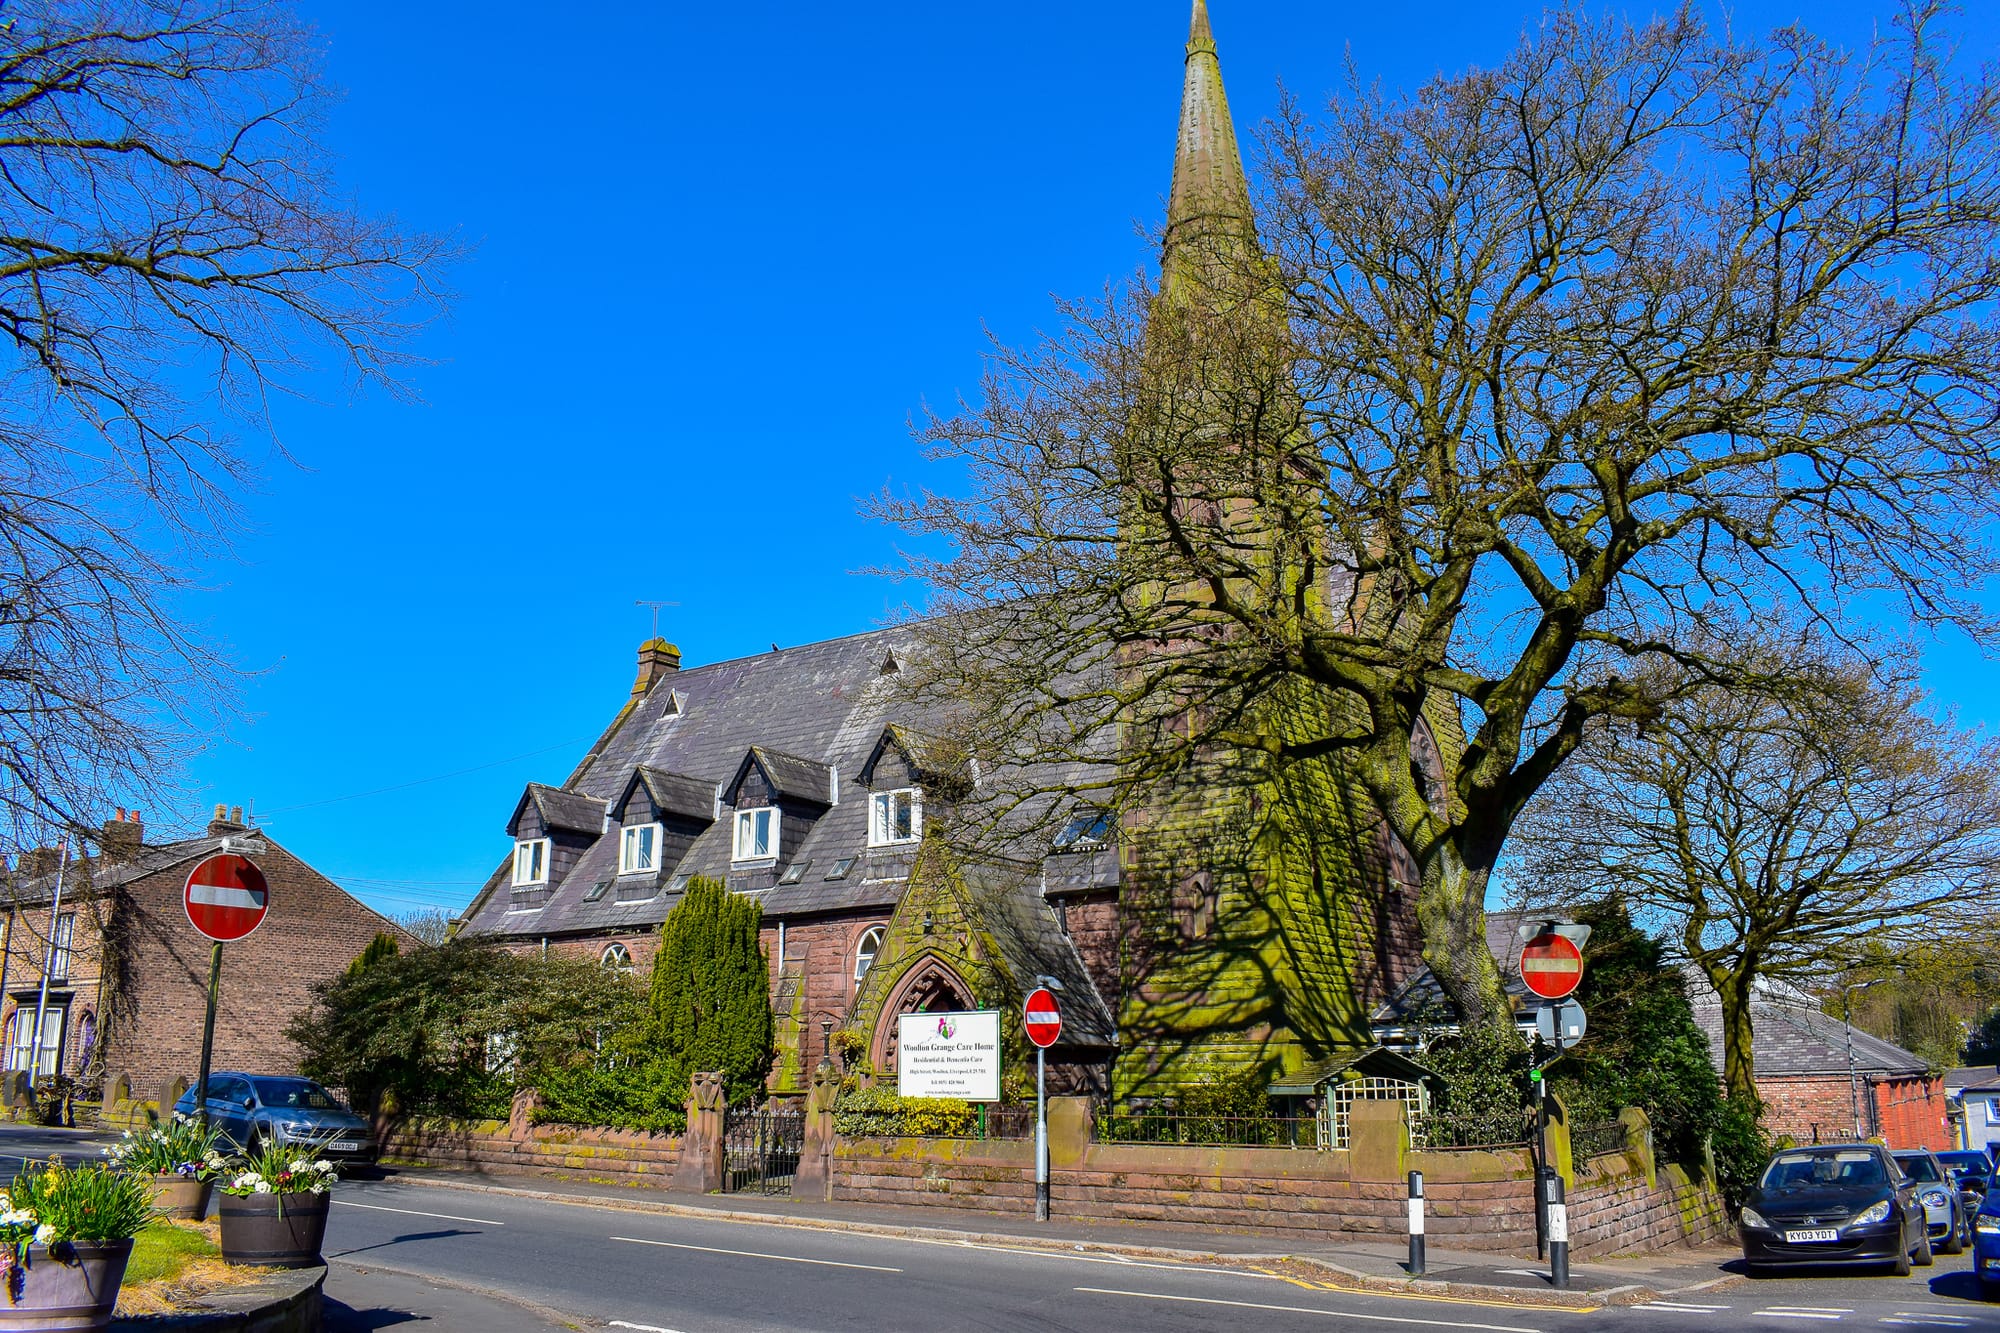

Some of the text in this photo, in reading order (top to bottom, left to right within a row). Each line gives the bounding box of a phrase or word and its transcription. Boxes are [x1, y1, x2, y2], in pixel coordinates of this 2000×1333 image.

[931, 1043, 955, 1053] Grange
[956, 1043, 973, 1051] Care
[974, 1042, 995, 1051] Home
[1790, 1230, 1832, 1240] KY03 YDT
